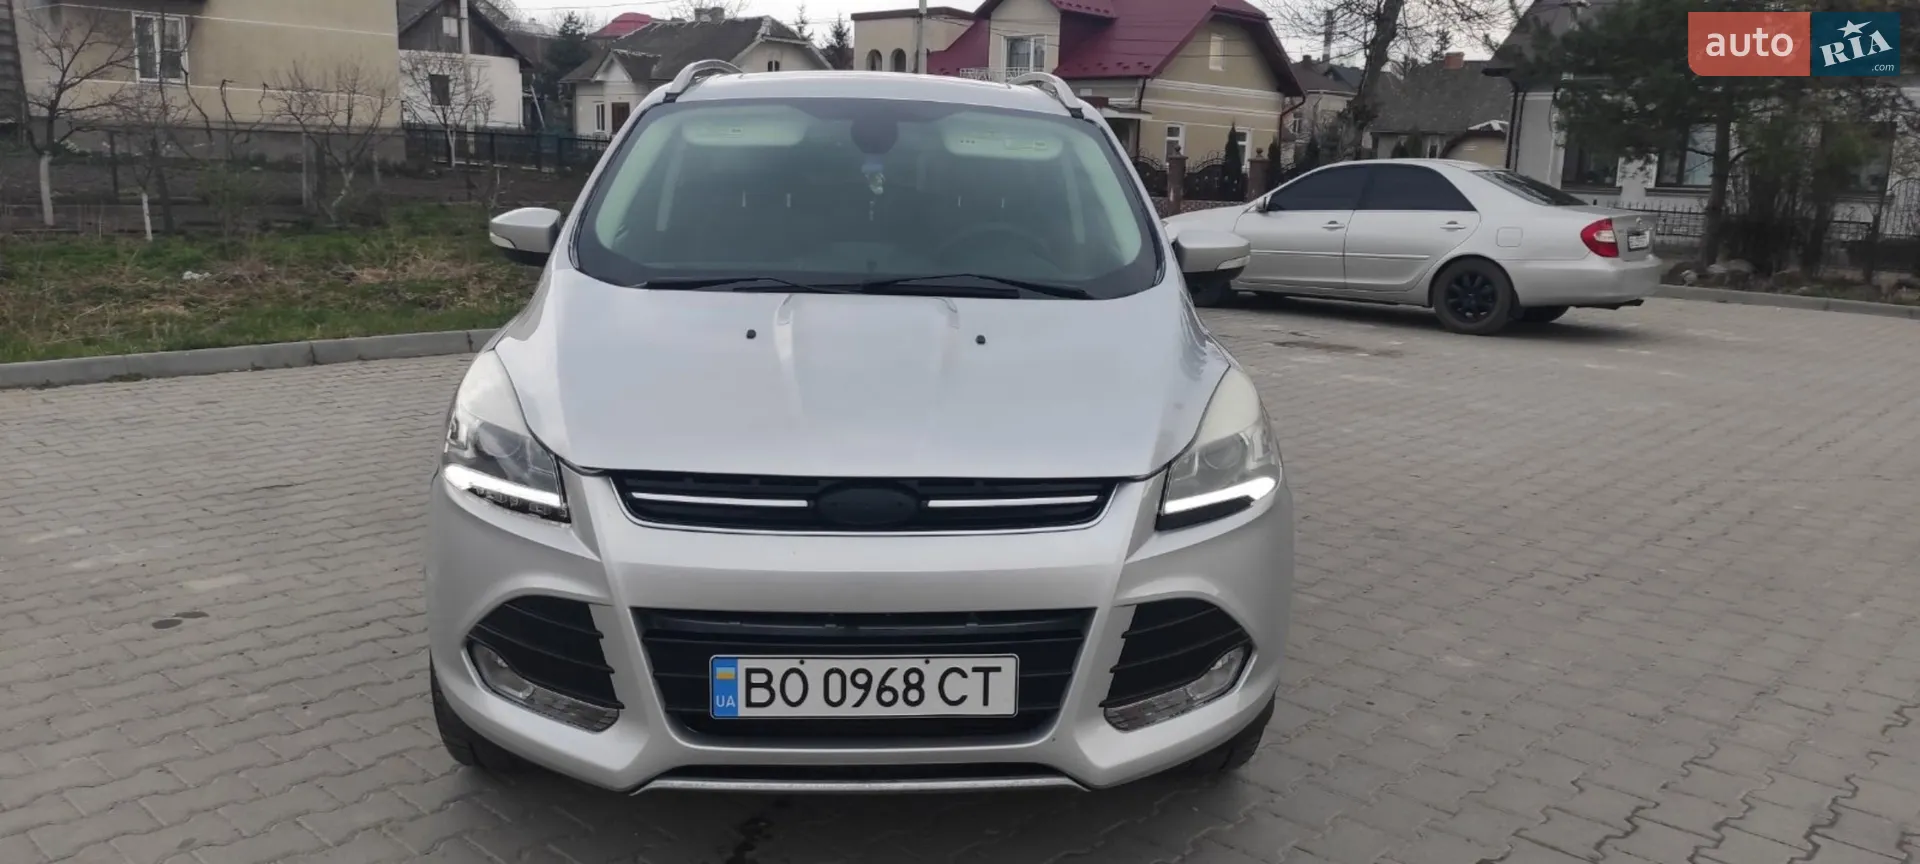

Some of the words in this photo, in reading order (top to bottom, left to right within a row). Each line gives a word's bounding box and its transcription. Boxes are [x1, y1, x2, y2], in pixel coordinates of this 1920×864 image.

[745, 666, 809, 708] BO
[823, 666, 926, 708] 0968
[937, 666, 1002, 707] CT
[716, 695, 736, 708] UA
